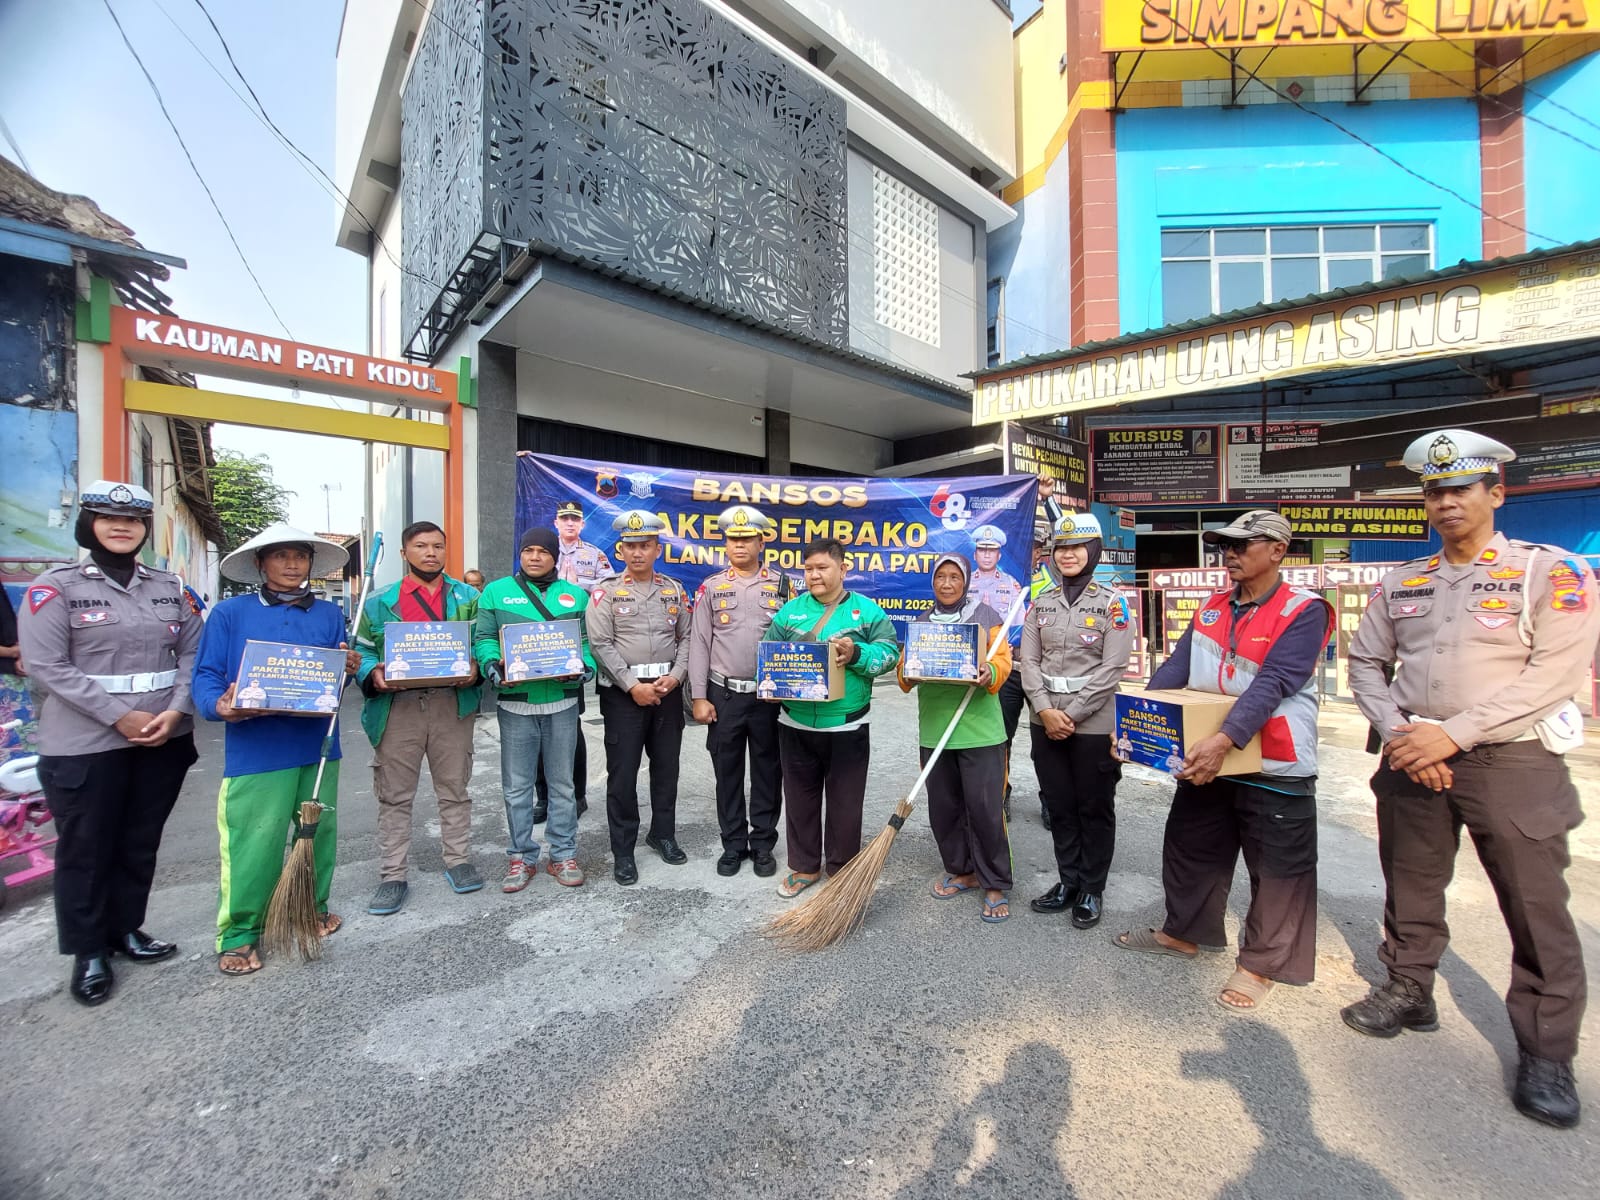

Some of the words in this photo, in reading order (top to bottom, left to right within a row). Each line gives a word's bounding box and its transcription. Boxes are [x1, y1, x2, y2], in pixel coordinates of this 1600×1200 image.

[1141, 0, 1409, 43] SIMPANG
[1436, 0, 1588, 33] LIMA
[135, 317, 282, 365] KAUMAN
[296, 347, 354, 378] PATI
[367, 361, 443, 393] KIDUL
[981, 344, 1167, 418] PENUKARAN
[1174, 320, 1294, 386] UANG
[1302, 285, 1482, 365] ASING
[1108, 429, 1184, 443] KURSUS
[1110, 443, 1152, 451] PEMBUATAN
[1012, 442, 1034, 459] REYAL
[1036, 448, 1067, 467] PECAHAN
[1069, 457, 1086, 471] KECIL
[1103, 451, 1131, 459] SARANG
[1133, 450, 1162, 458] BURUNG
[1014, 457, 1038, 475] UNTUK
[692, 477, 868, 508] BANSOS
[1280, 507, 1330, 520] PUSAT
[1333, 507, 1428, 521] PENUKARAN
[656, 512, 723, 540] AKE
[763, 517, 928, 548] SEMBAKO
[1351, 523, 1424, 534] ASING
[665, 543, 732, 566] LANT
[764, 549, 885, 572] POLSTA
[1099, 551, 1116, 563] OILET
[1118, 551, 1135, 563] TOILET
[1171, 571, 1227, 587] TOILET
[1281, 568, 1318, 586] LET
[1349, 566, 1394, 585] TOI
[70, 599, 112, 609] RISMA
[502, 597, 528, 605] Grab
[873, 598, 903, 609] HUN
[905, 599, 934, 610] 2023
[888, 614, 917, 622] DONESIA
[1079, 607, 1106, 615] POLRI
[405, 633, 453, 641] BANSOS
[521, 632, 565, 643] BANSOS
[921, 633, 962, 641] BANSOS
[267, 656, 325, 671] BANSOS
[773, 653, 814, 661] BANSOS
[252, 666, 287, 674] PAKET
[288, 669, 335, 678] SEMBAKO
[1128, 709, 1168, 726] BANSOS
[1121, 717, 1141, 727] PAKET
[1143, 721, 1177, 736] SEMBAKO
